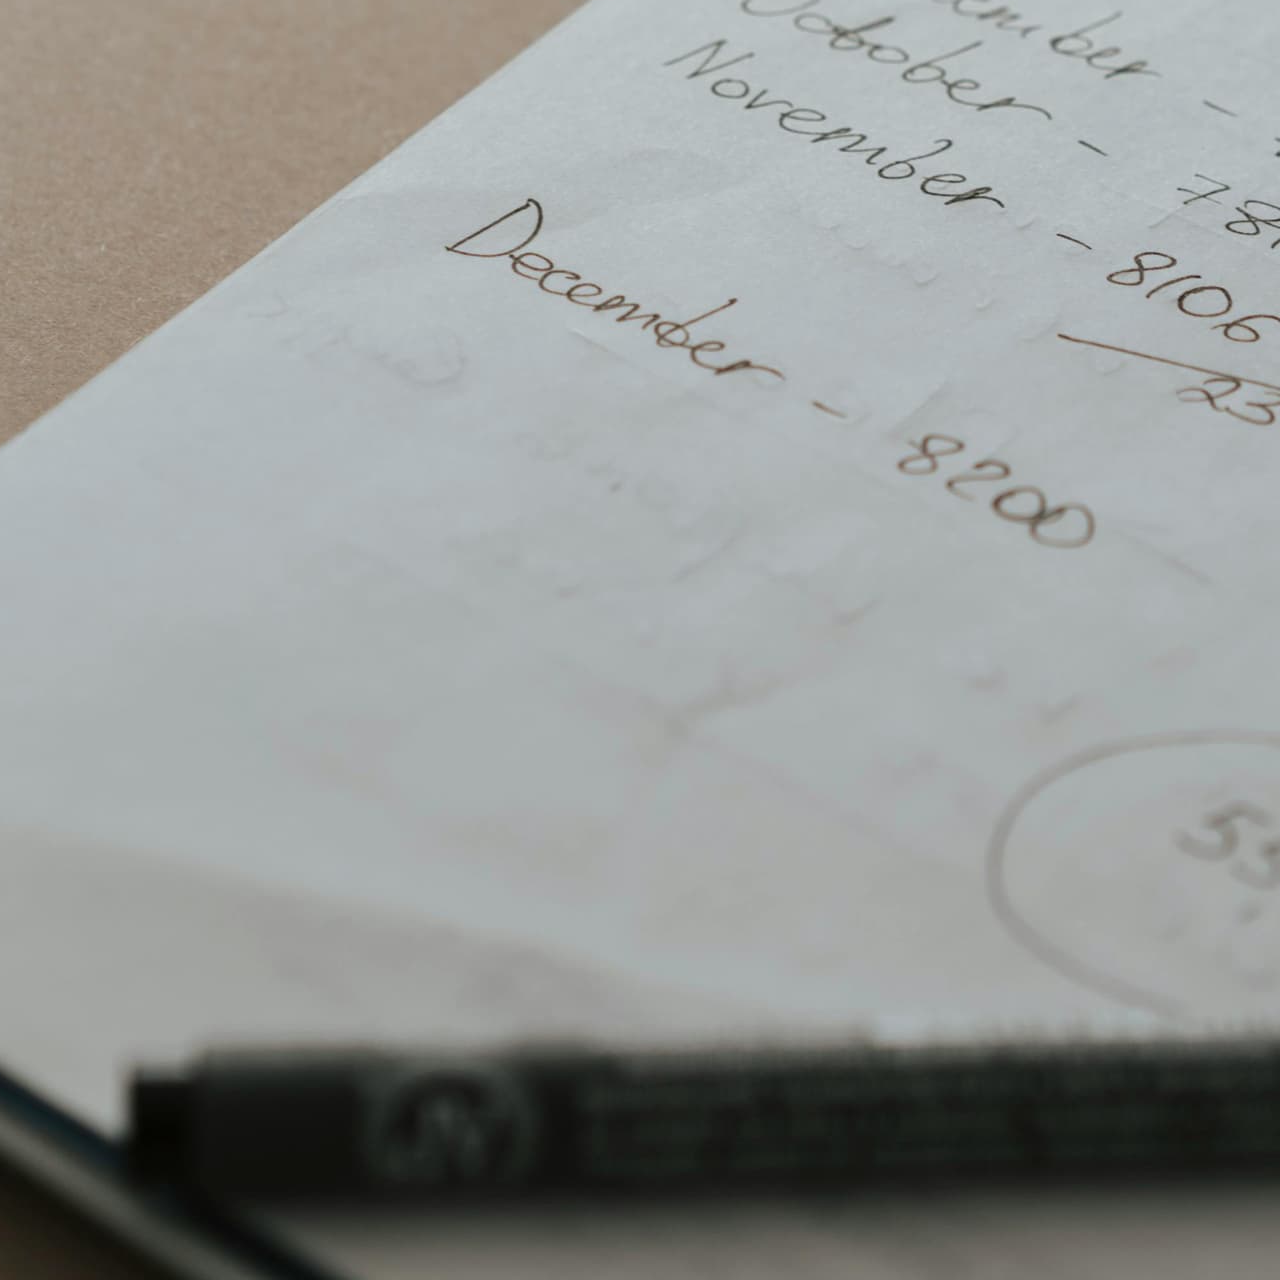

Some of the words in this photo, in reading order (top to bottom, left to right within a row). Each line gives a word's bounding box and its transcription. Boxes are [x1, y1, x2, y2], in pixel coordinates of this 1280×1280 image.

[662, 37, 1007, 210] November
[444, 196, 787, 381] December
[895, 430, 1098, 551] 8200
